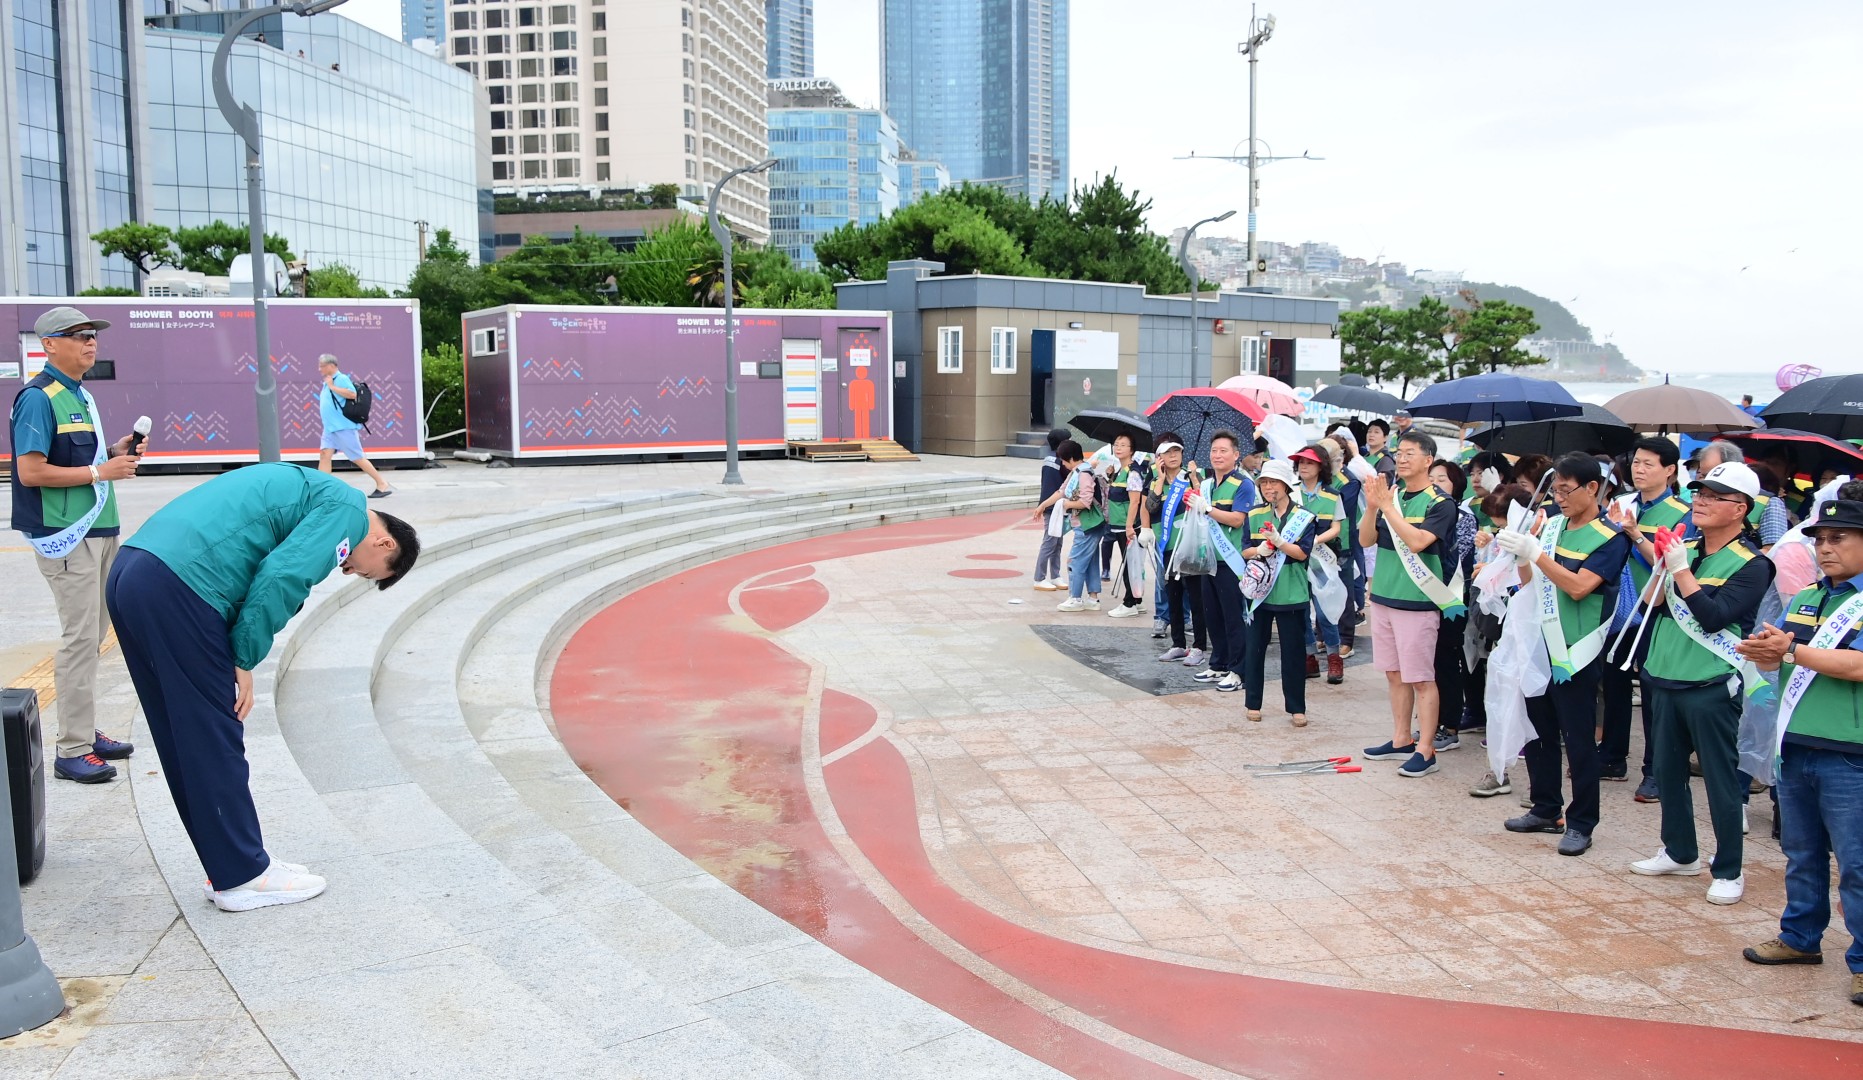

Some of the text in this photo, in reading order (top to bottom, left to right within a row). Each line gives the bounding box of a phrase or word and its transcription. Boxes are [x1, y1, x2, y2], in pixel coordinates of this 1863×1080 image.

[773, 80, 832, 92] PALEDECZ
[129, 310, 214, 319] SHOWER BOOTH
[314, 311, 382, 326] 해운대해수욕장
[676, 318, 740, 326] SHOWER BOTH
[41, 533, 78, 554] 살수있다
[1542, 584, 1555, 615] 살수있다
